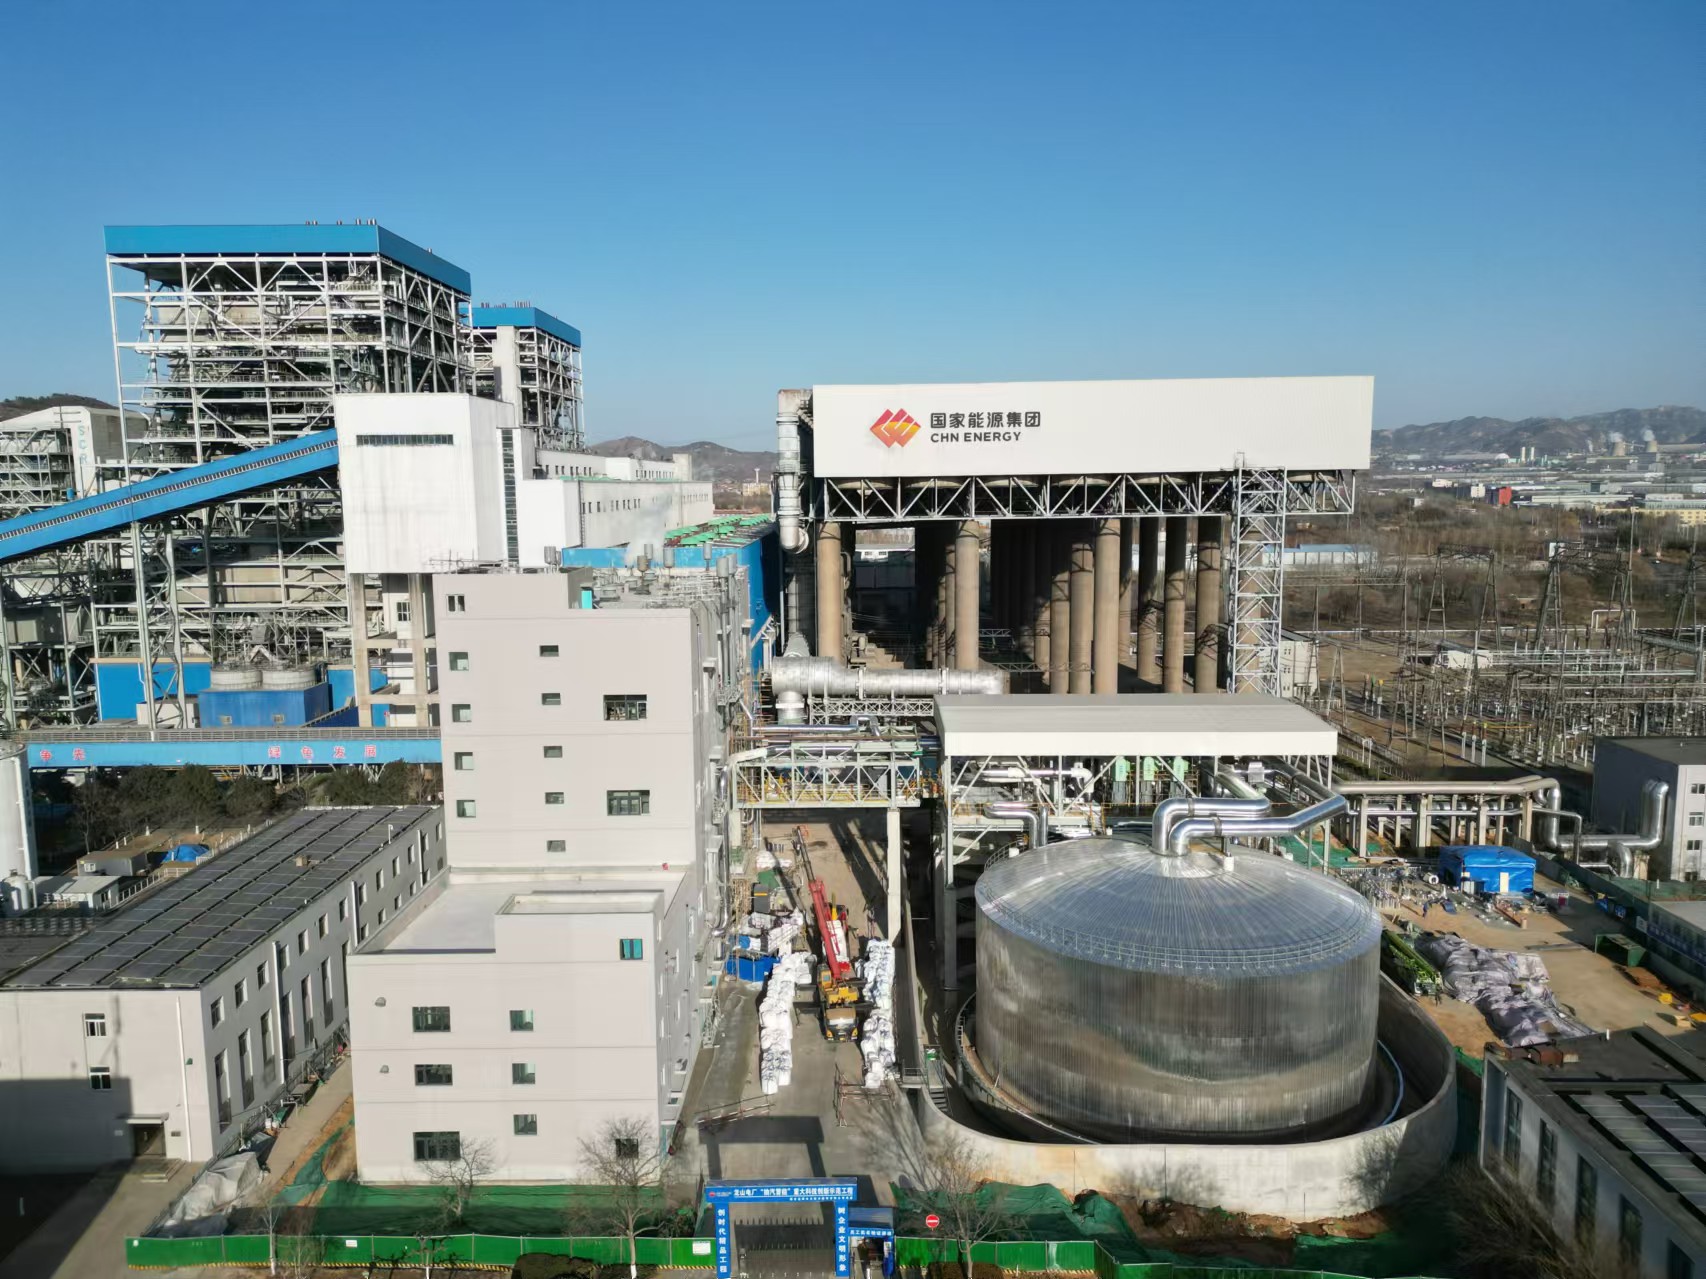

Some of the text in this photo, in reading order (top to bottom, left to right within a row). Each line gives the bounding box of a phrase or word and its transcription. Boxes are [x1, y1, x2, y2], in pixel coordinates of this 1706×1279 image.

[930, 411, 1041, 429] 国家能源集团
[930, 431, 1022, 443] CHN ENERGY
[40, 747, 86, 761] 争先
[267, 744, 377, 760] 绿色发展
[837, 1207, 847, 1272] 树企业文明形象
